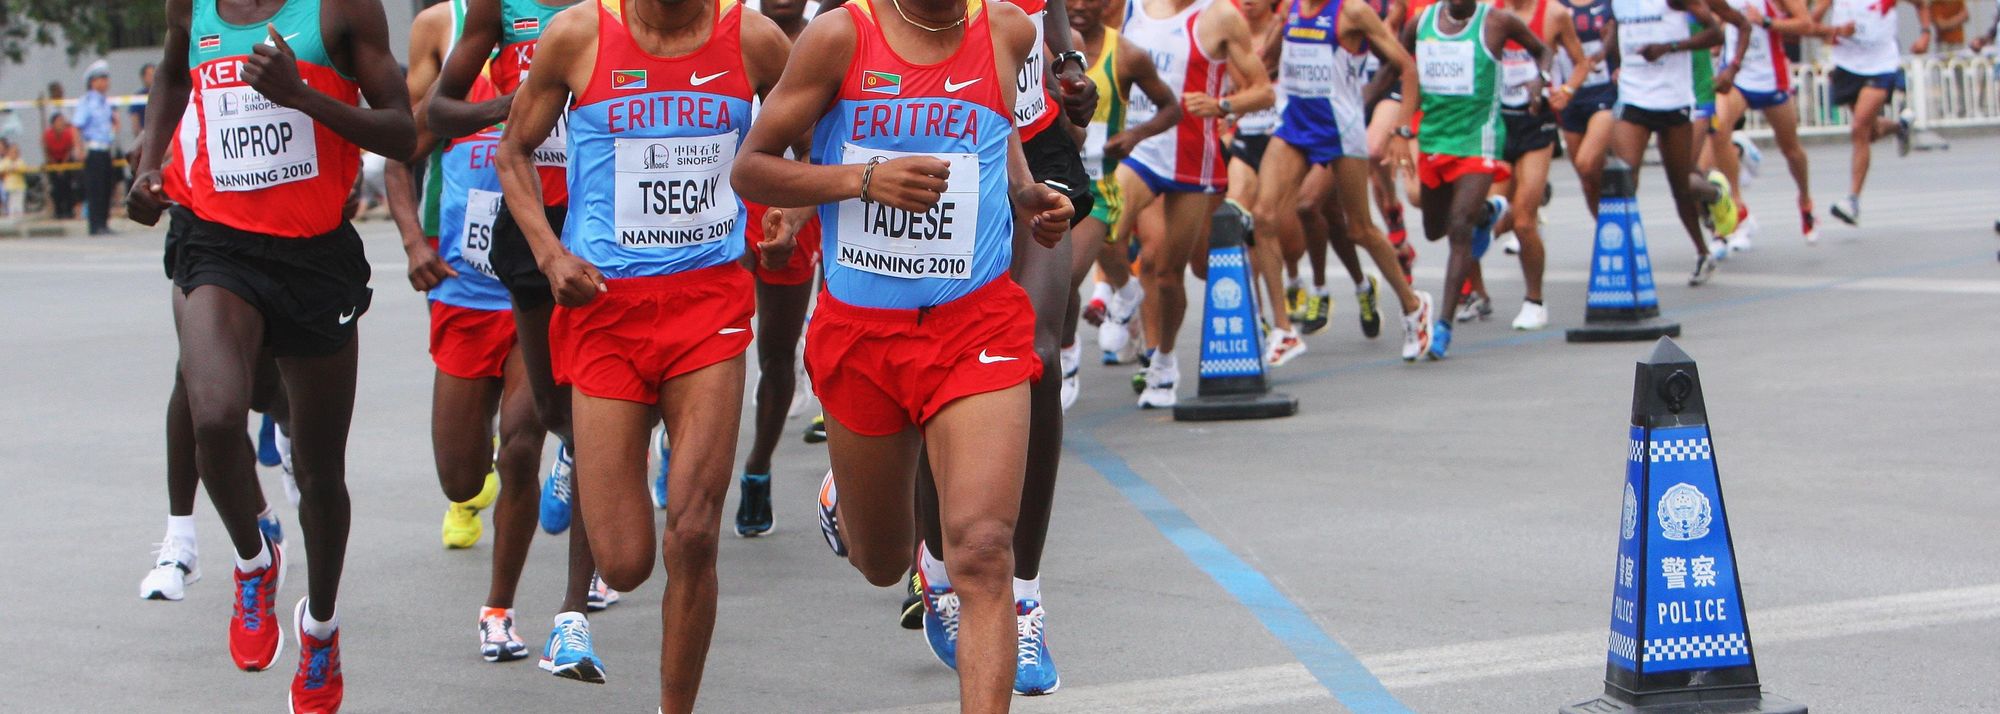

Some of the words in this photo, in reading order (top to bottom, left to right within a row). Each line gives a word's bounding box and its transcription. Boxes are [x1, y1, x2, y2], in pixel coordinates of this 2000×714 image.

[1017, 53, 1039, 93] UTO
[608, 96, 731, 134] ERITREA
[851, 103, 978, 145] ERITREA
[220, 121, 293, 159] KIPROP
[674, 143, 720, 156] 中国石化
[533, 151, 567, 163] NANN
[677, 155, 718, 165] SINOPEC
[215, 169, 278, 187] NANNING
[282, 162, 312, 178] 2010
[638, 173, 720, 215] TSEGAY
[622, 228, 703, 245] NANNING
[708, 218, 734, 239] 2010
[860, 197, 955, 240] TADESE
[842, 246, 924, 274] NANNING
[928, 257, 965, 275] 2010
[1209, 339, 1249, 354] POLICE
[1661, 556, 1716, 589] 警察
[1615, 598, 1634, 623] POLICE
[1658, 598, 1727, 624] POLICE
